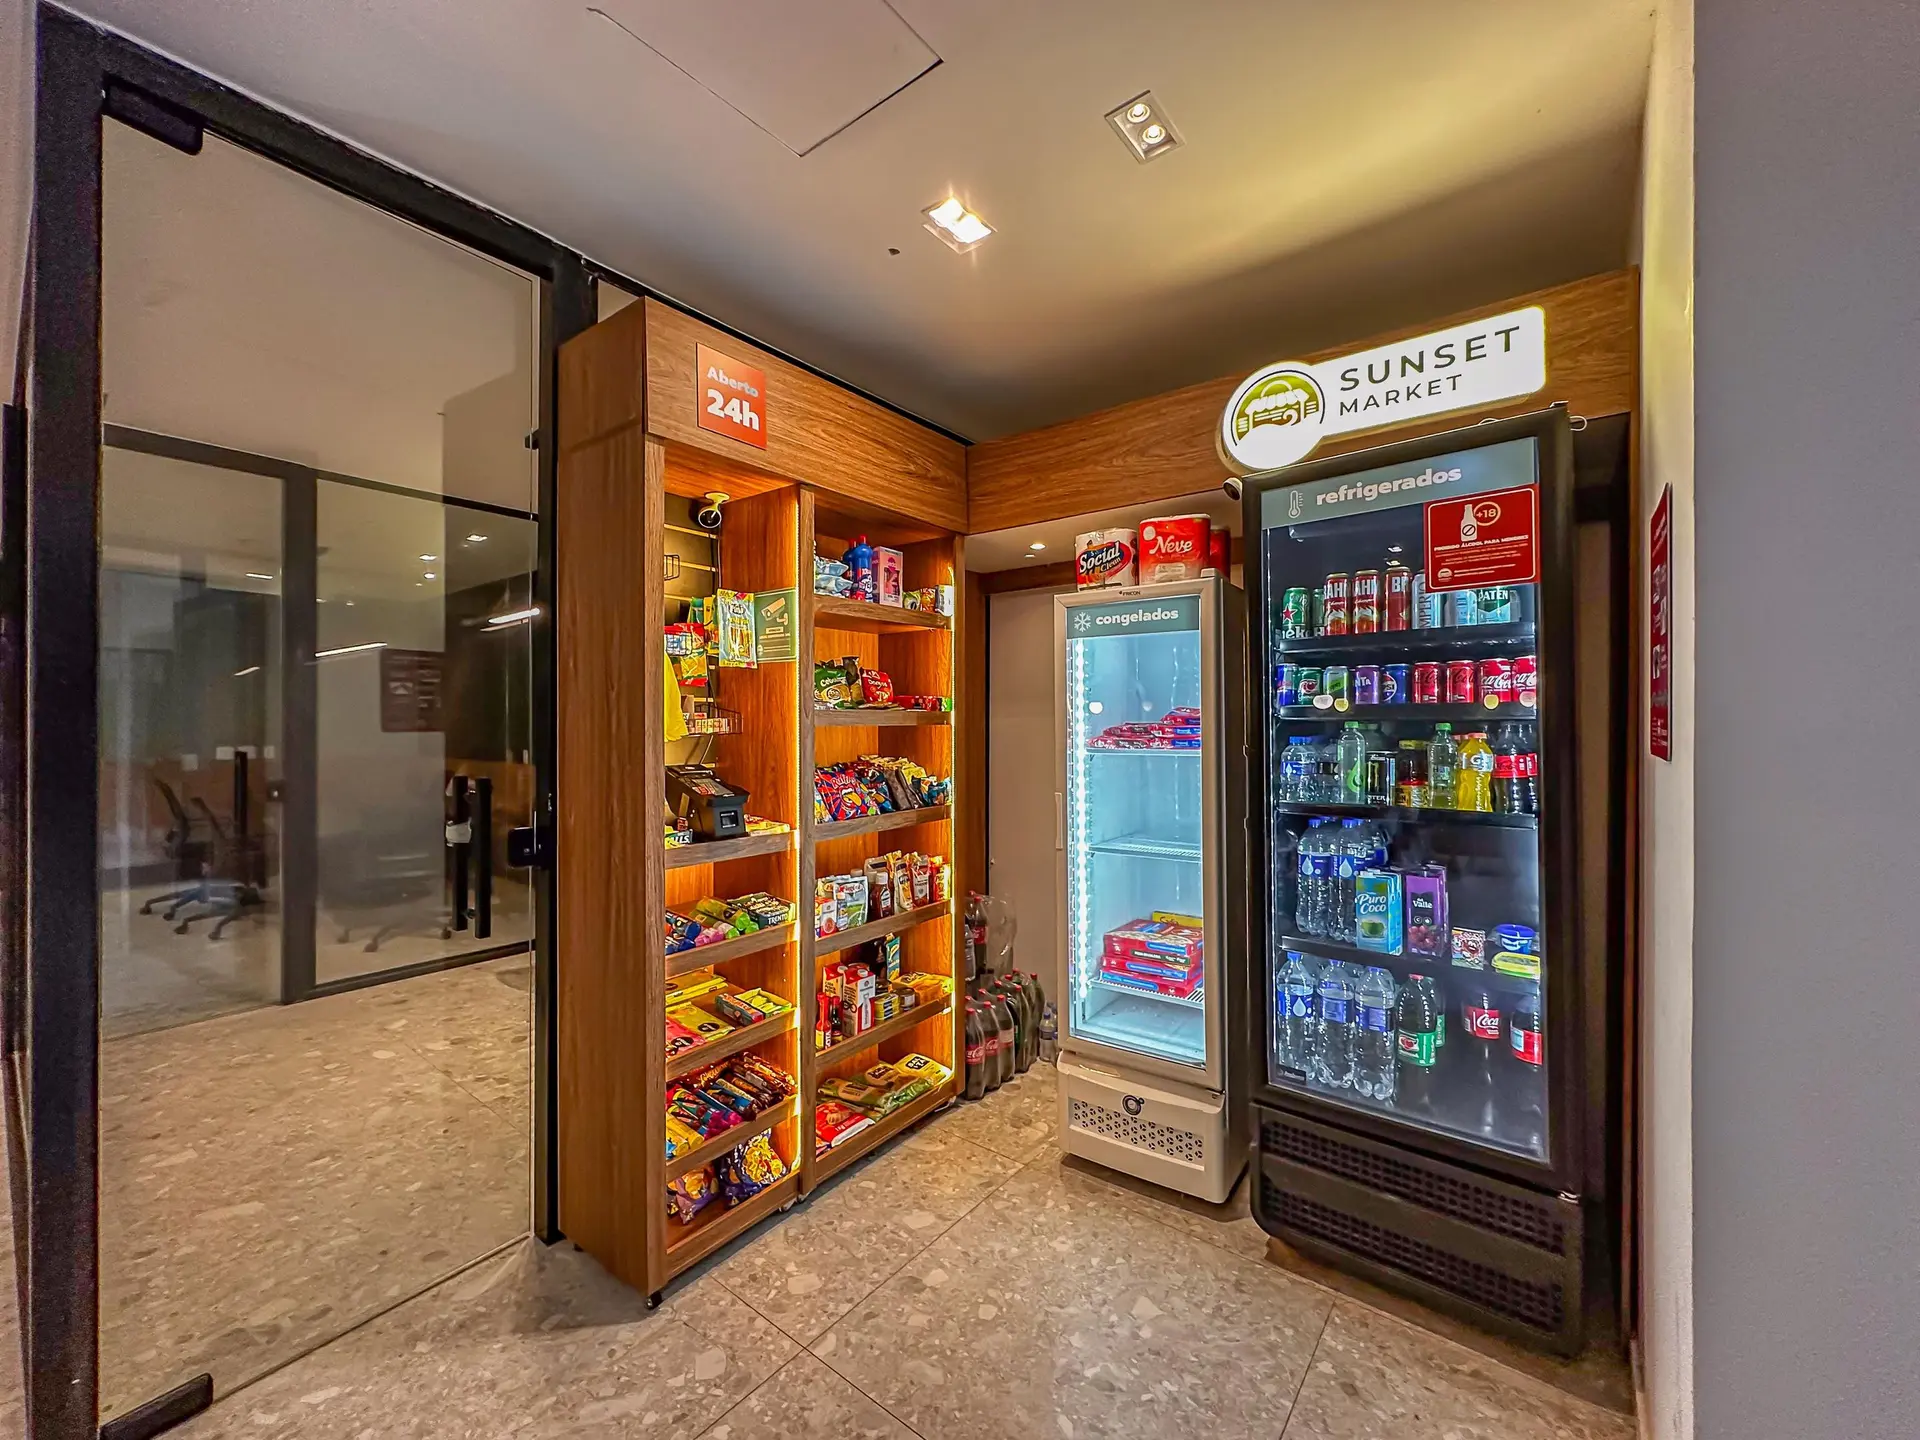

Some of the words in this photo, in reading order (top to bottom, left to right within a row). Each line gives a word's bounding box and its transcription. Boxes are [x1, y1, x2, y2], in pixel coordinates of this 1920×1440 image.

[1339, 325, 1520, 391] SUNSET
[706, 366, 760, 398] Aberto
[1339, 374, 1462, 416] MARKET
[706, 388, 760, 431] 24h
[1316, 467, 1462, 506] refrigerados
[1476, 508, 1497, 518] +18
[1149, 535, 1193, 555] Neve
[1079, 541, 1120, 573] Social
[1100, 557, 1121, 572] Clean
[1095, 608, 1179, 626] congelados
[1357, 893, 1386, 904] Puro
[1360, 903, 1386, 914] Coco
[1412, 900, 1433, 909] Valle
